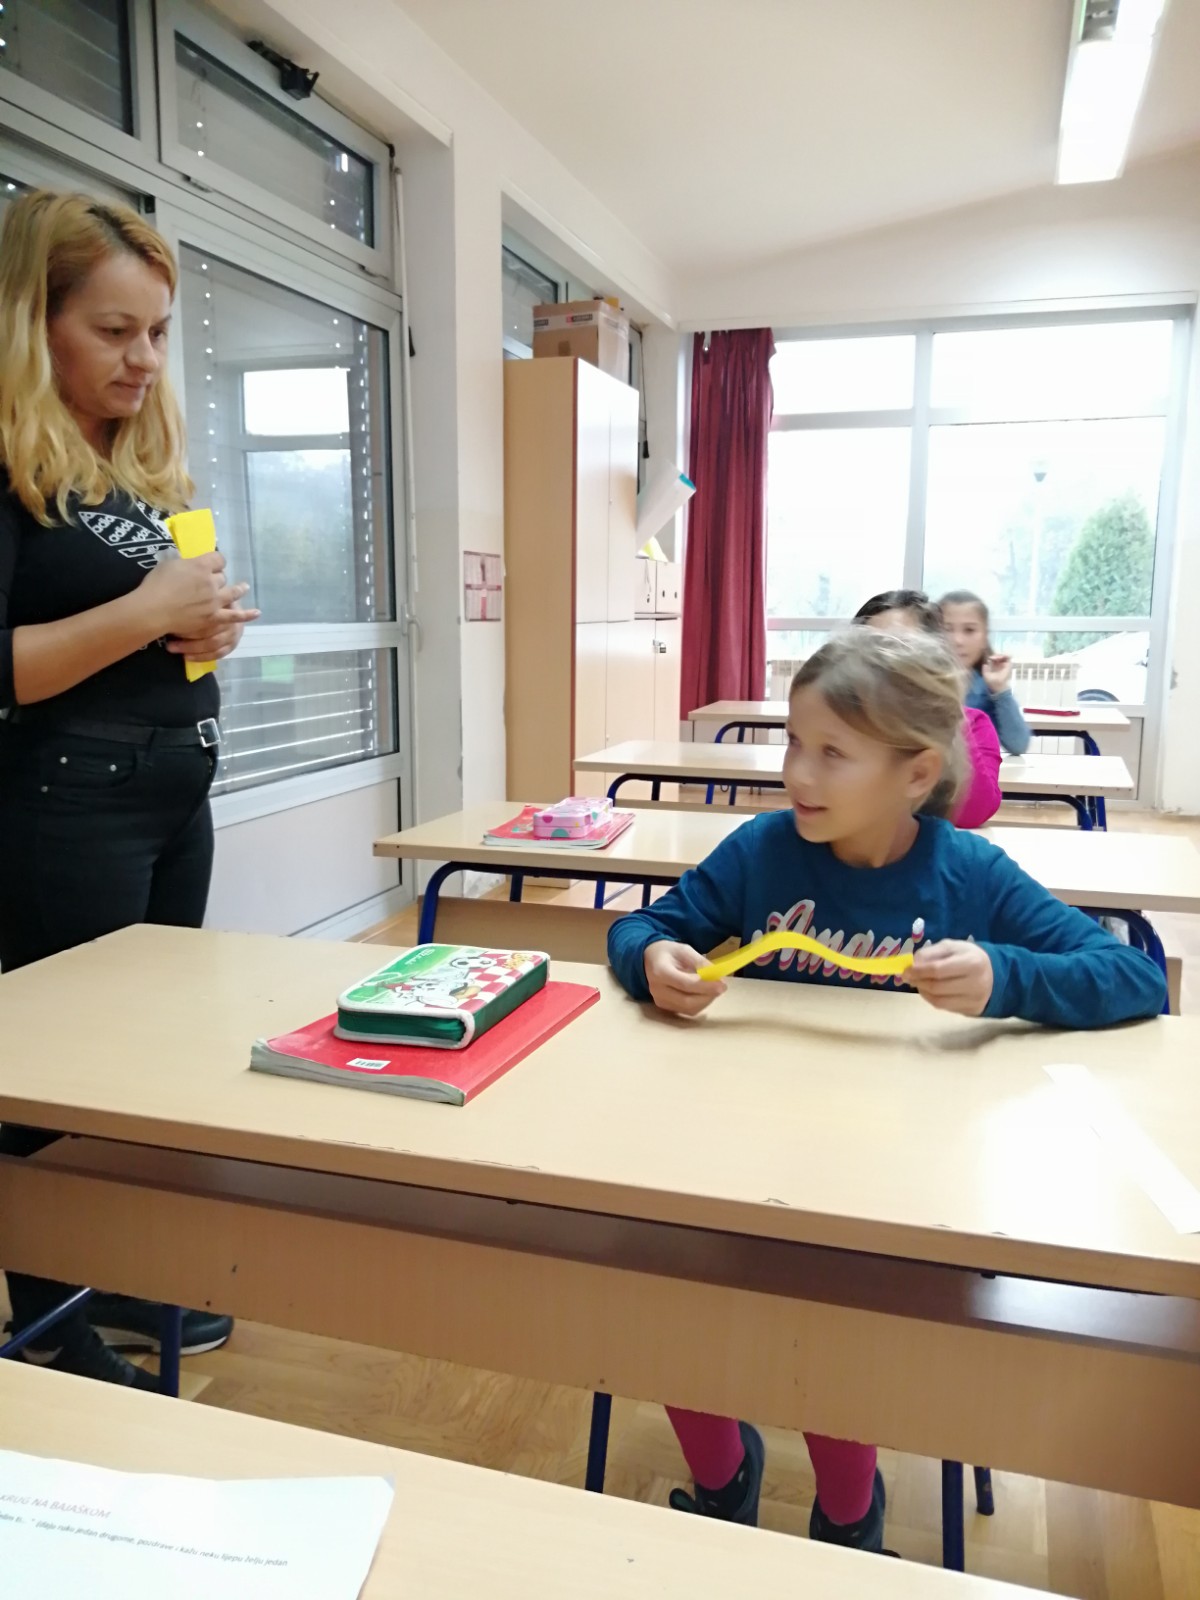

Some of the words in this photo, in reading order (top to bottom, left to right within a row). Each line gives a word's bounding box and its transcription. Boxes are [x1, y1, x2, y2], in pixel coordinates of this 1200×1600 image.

[751, 899, 975, 987] Amazi
[31, 1498, 49, 1508] NA
[136, 1538, 175, 1552] pozdrave
[199, 1549, 220, 1560] neku
[263, 1558, 288, 1568] jedan
